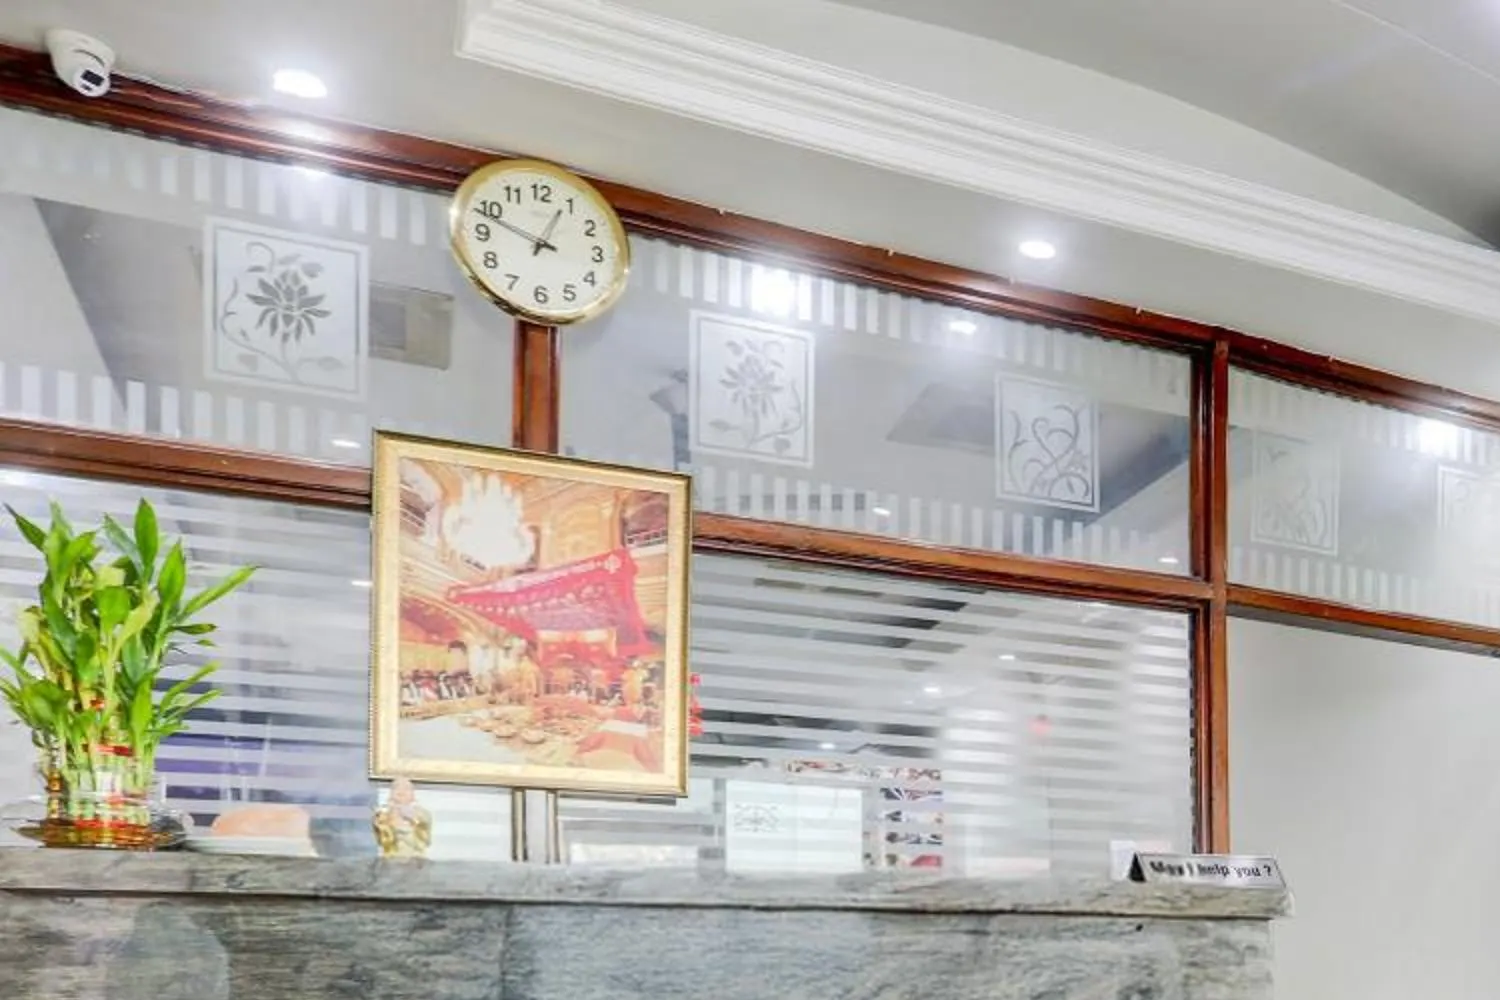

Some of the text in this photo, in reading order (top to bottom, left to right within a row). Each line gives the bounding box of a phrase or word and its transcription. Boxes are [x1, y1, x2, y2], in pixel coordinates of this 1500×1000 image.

[504, 185, 521, 204] 11
[531, 183, 552, 203] 12
[479, 200, 503, 220] 10
[565, 198, 574, 215] 1
[475, 223, 491, 242] 9
[584, 219, 596, 237] 2
[483, 251, 498, 269] 8
[591, 245, 604, 263] 3
[504, 273, 520, 290] 7
[582, 271, 596, 287] 4
[533, 285, 549, 304] 6
[562, 284, 577, 302] 5
[1197, 863, 1230, 877] help
[1232, 864, 1261, 878] you
